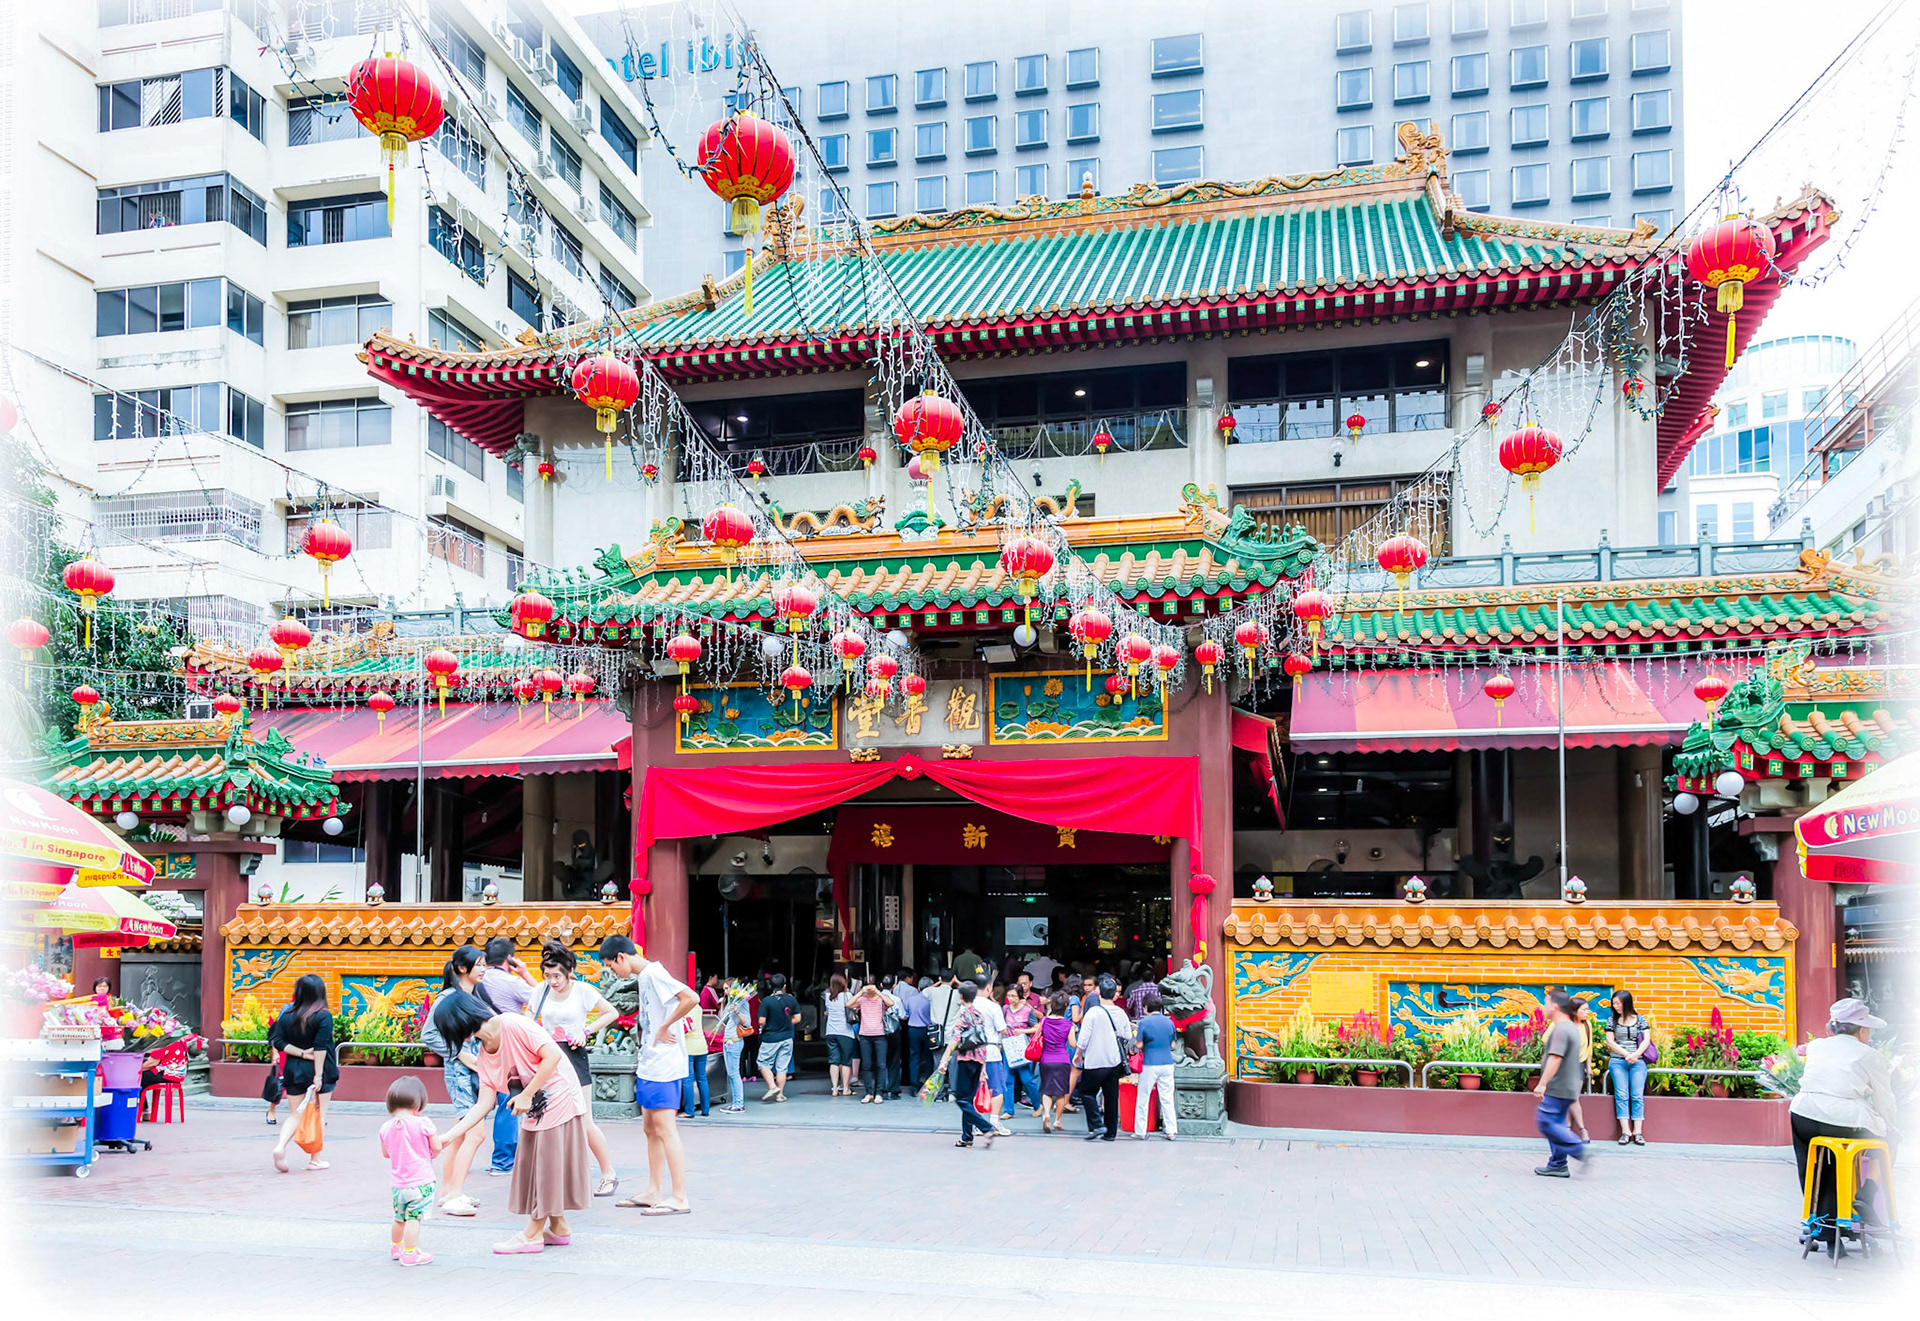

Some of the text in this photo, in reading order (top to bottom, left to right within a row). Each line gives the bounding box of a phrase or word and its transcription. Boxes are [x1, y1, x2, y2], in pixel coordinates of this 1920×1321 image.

[606, 42, 669, 82] tel
[20, 837, 28, 849] 1
[31, 841, 43, 852] in
[47, 844, 106, 863] Singapore
